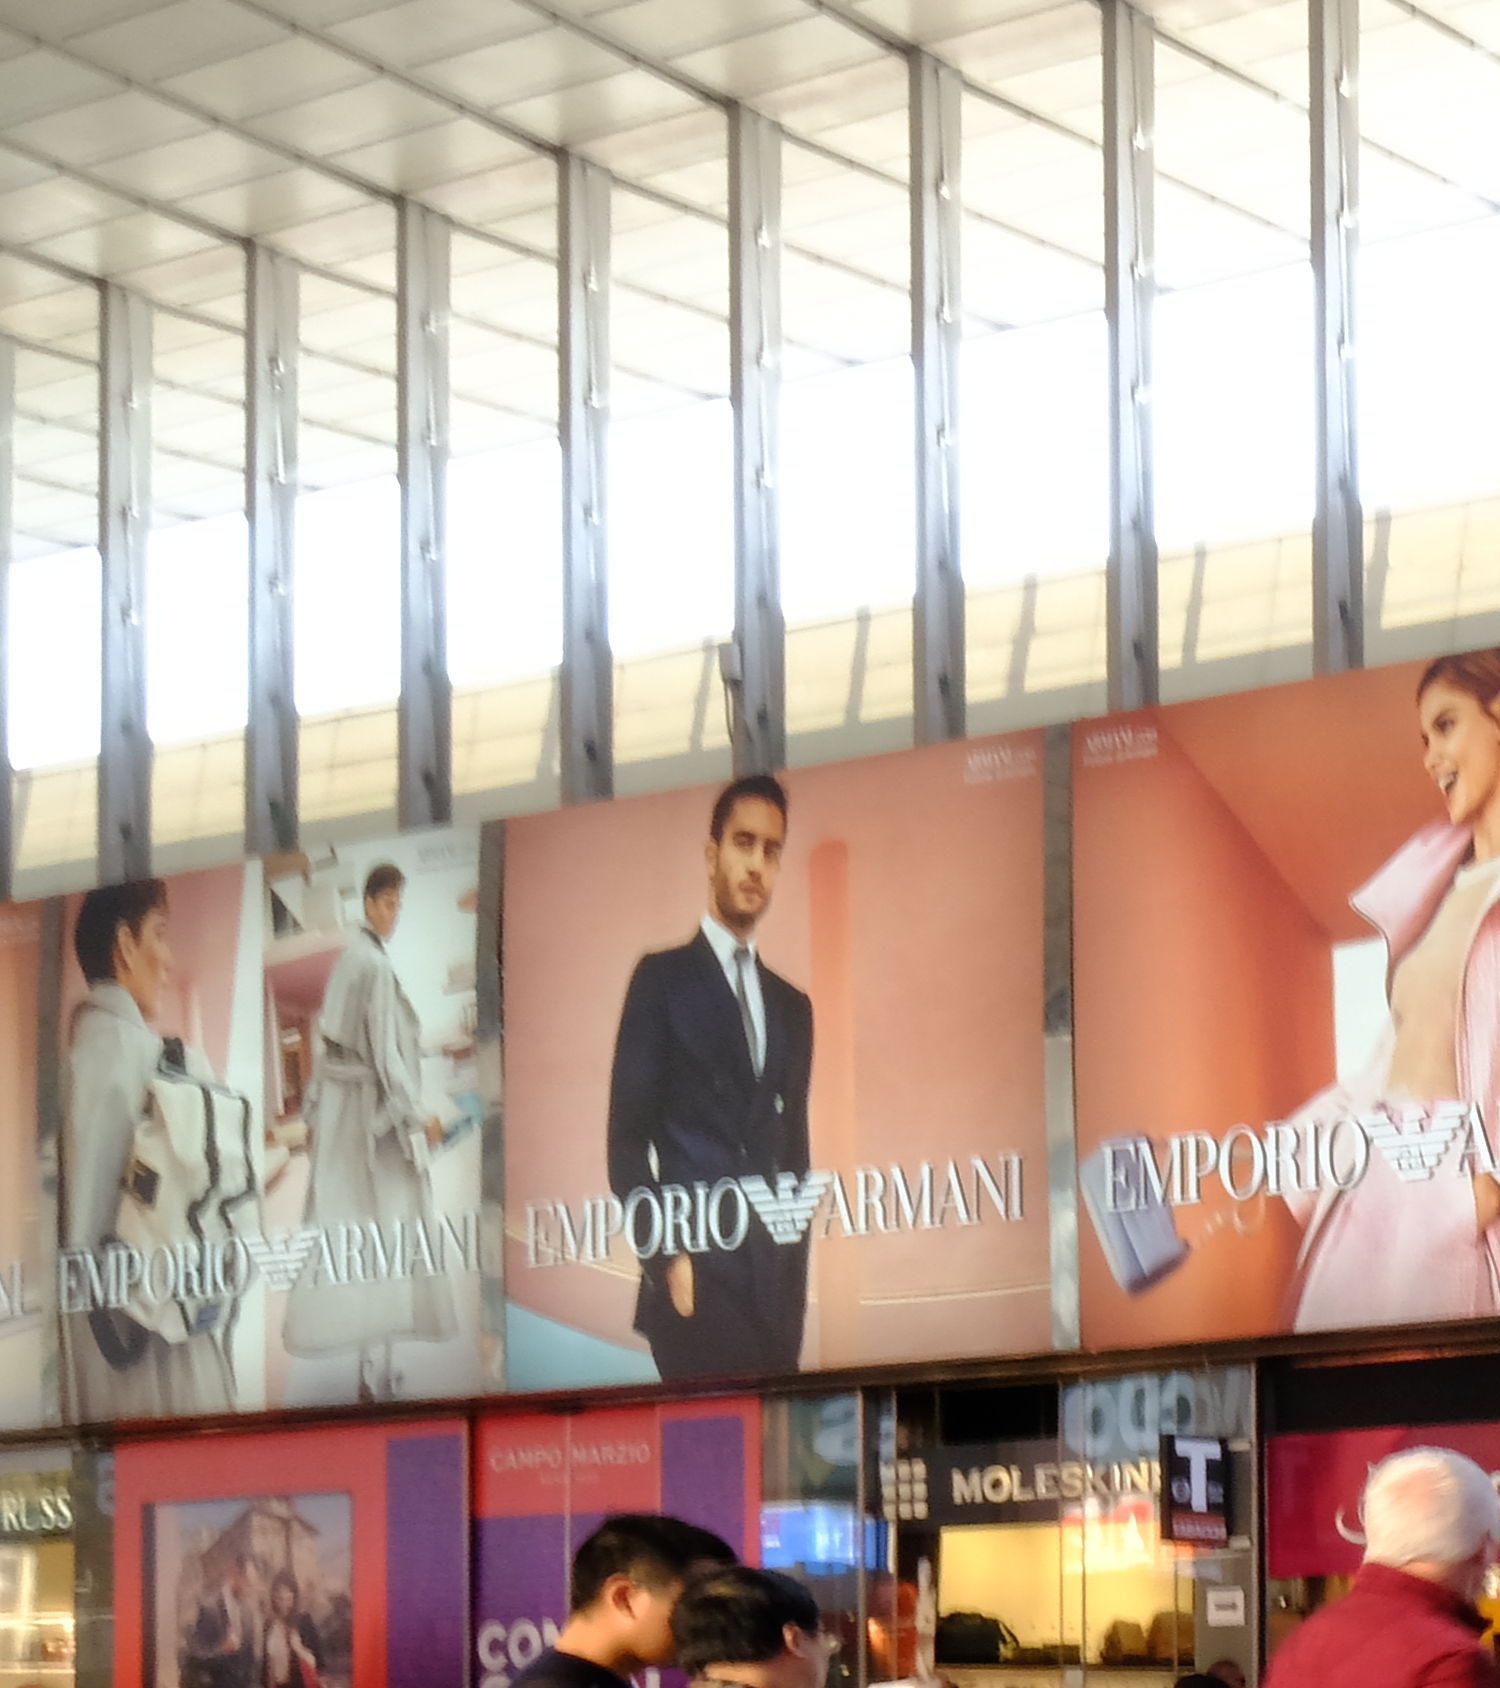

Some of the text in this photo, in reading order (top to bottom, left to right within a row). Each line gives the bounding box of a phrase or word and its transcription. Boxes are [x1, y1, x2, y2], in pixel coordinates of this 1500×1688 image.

[525, 1153, 1026, 1269] EMPORIO ARMANI
[1100, 1118, 1372, 1214] EMPORIO
[59, 1237, 250, 1315] EMPORIO
[307, 1211, 482, 1286] ARMANI
[489, 1439, 652, 1473] CAMPO MARZIO
[1173, 1436, 1222, 1513] T
